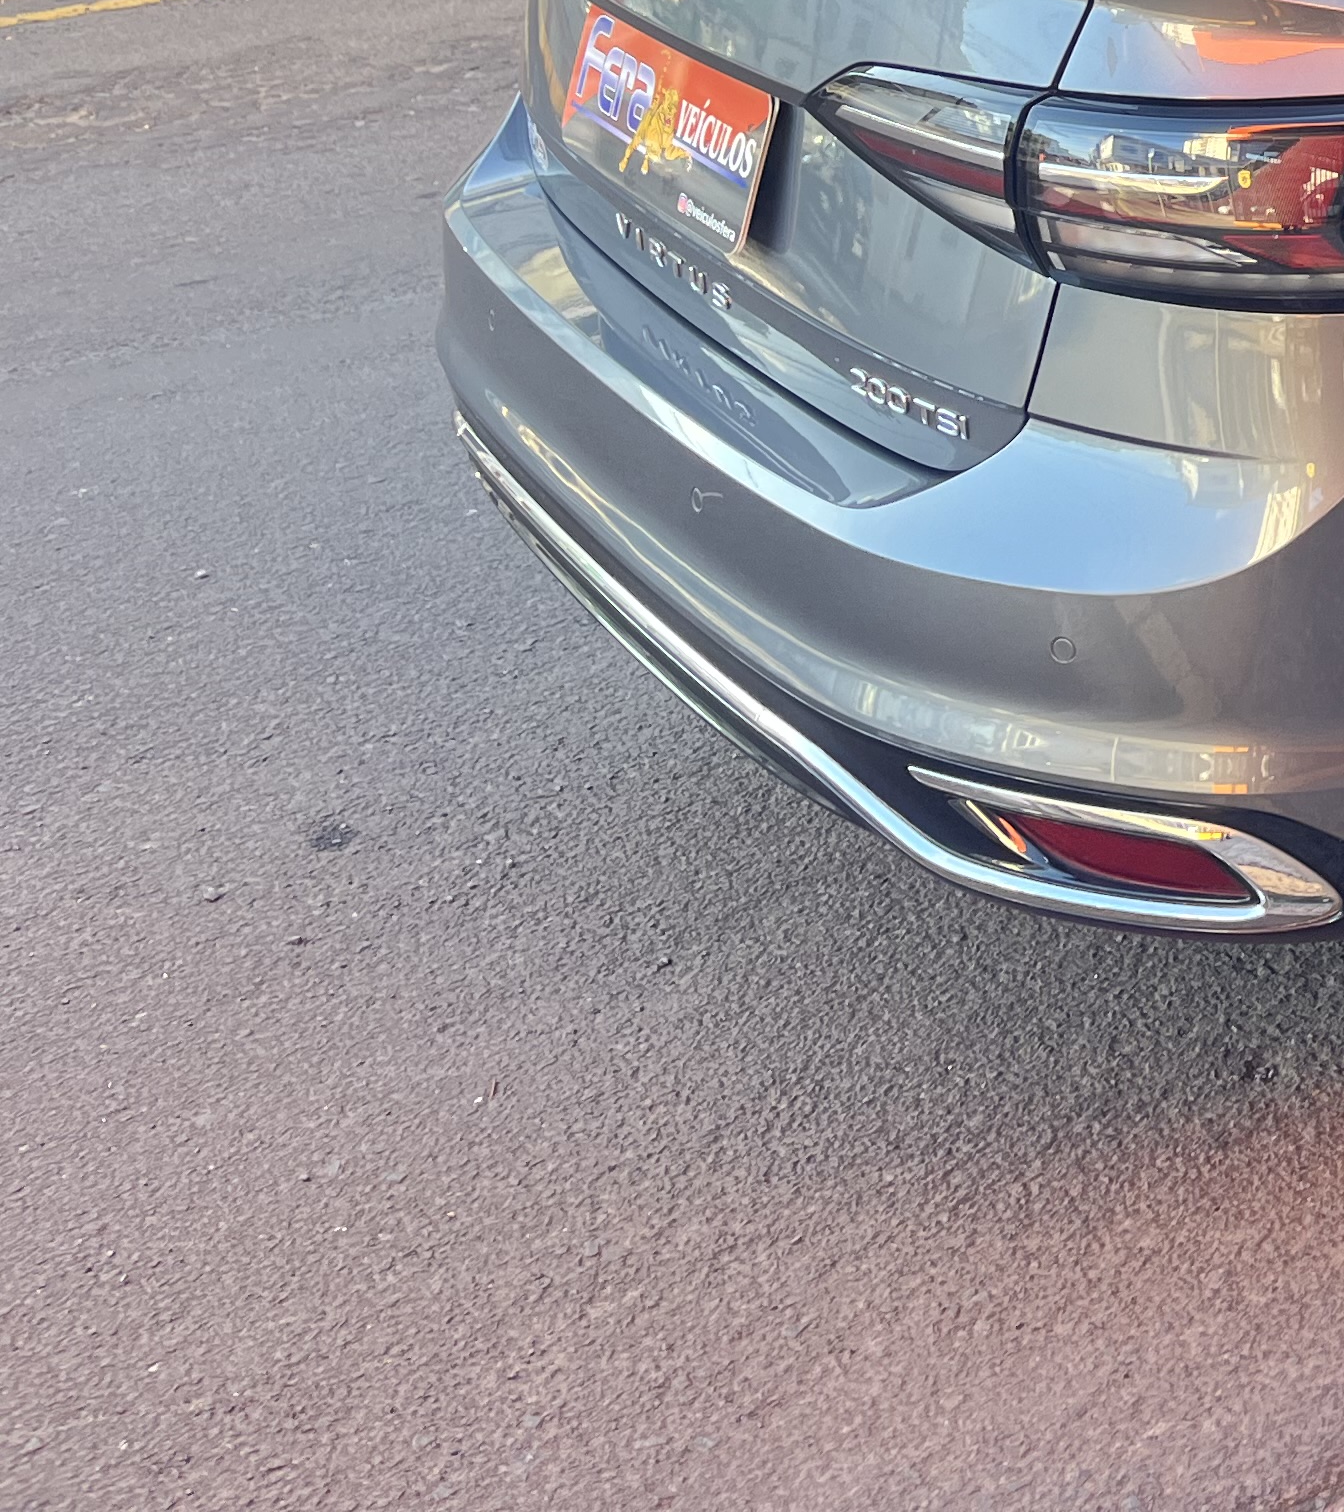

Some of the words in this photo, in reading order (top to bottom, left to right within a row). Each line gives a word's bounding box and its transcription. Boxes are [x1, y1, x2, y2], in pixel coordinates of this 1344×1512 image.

[575, 15, 656, 135] Fera
[676, 98, 757, 179] VEÍCULOS
[615, 212, 733, 310] VIRTUS
[686, 198, 736, 243] @veiculosfera
